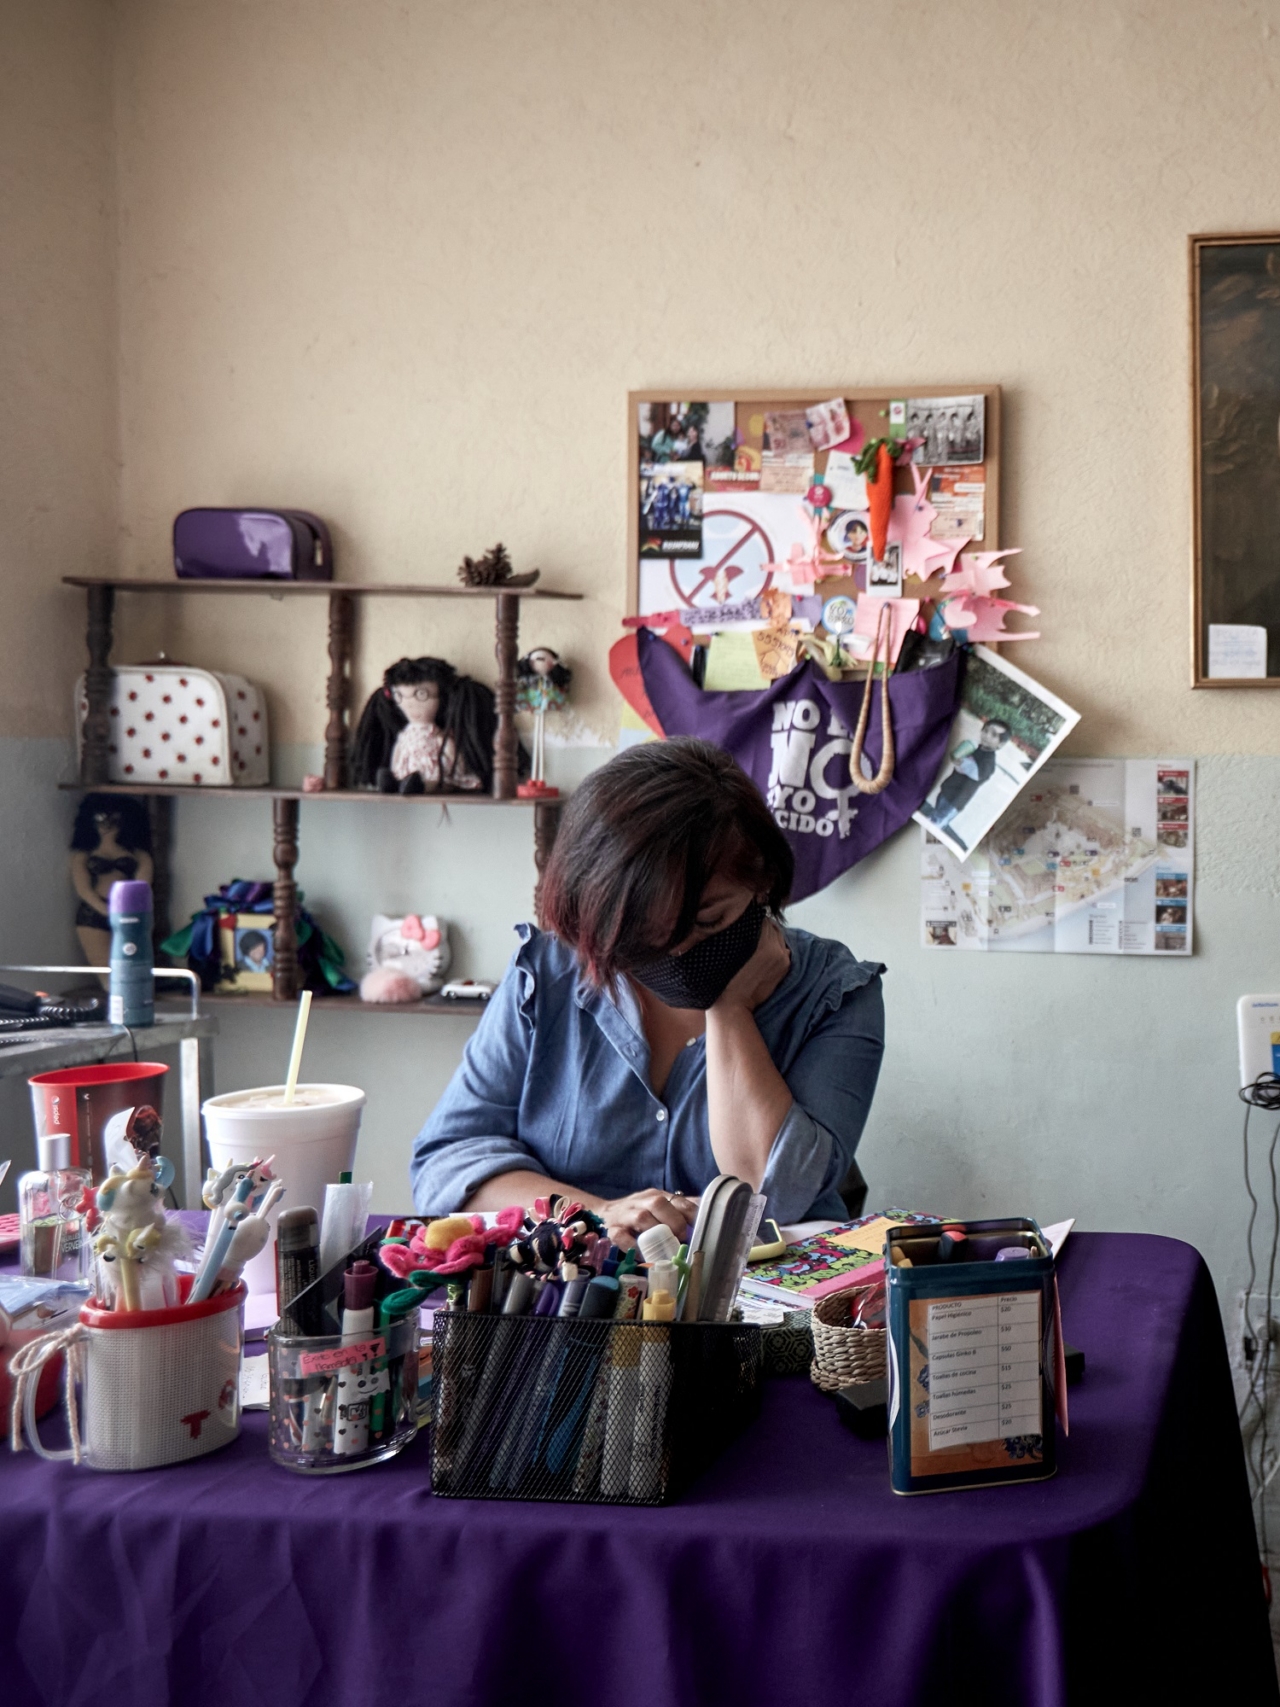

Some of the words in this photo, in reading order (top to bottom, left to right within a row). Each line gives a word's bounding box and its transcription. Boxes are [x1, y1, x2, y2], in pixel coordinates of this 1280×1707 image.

[771, 699, 821, 731] NO
[774, 810, 834, 837] CIDO
[52, 1105, 61, 1125] pepsi
[932, 1302, 962, 1310] PRODUCTO
[932, 1333, 949, 1341] Jarabe
[933, 1410, 967, 1421] Desodorante
